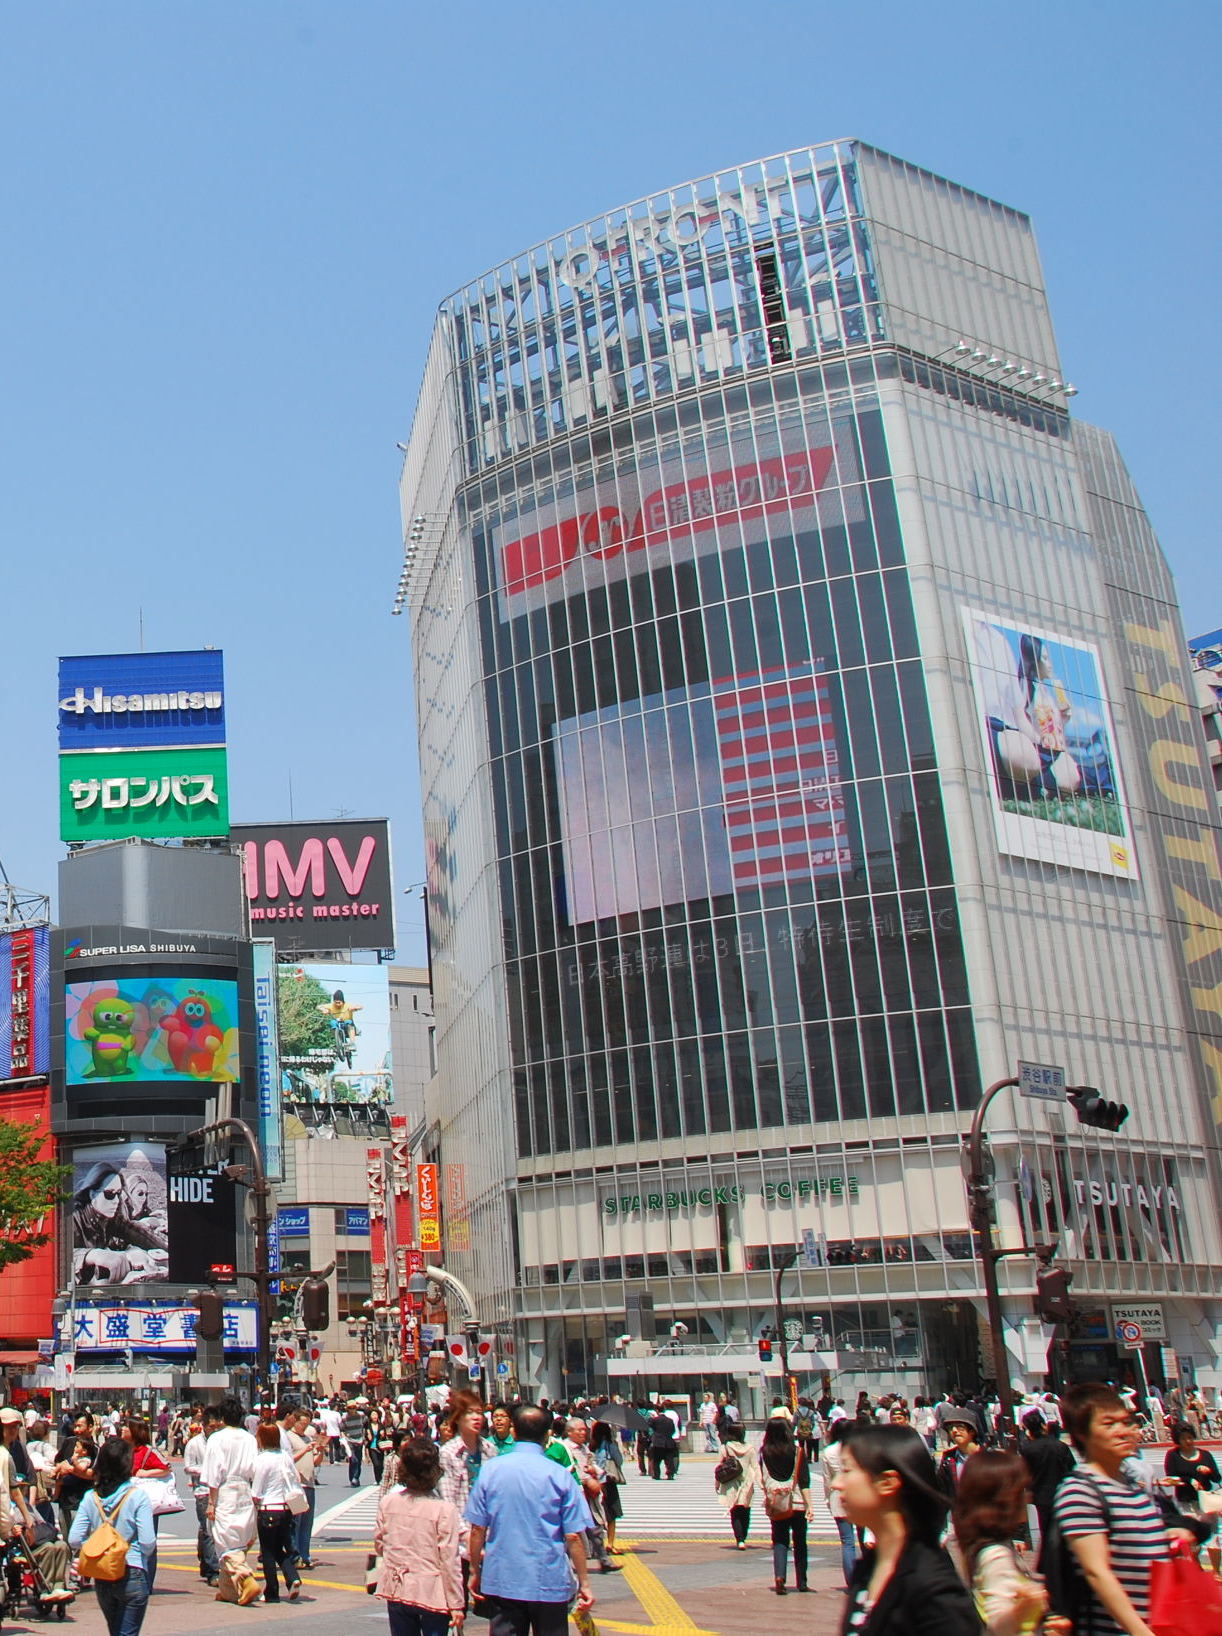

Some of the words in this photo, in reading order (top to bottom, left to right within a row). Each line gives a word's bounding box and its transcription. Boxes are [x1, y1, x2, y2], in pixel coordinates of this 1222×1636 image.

[59, 686, 222, 714] Hisamitsu
[69, 774, 219, 810] サロンパス
[251, 902, 304, 919] music
[312, 901, 380, 918] master
[79, 946, 117, 957] SUPER
[120, 944, 146, 953] LISA
[150, 943, 196, 953] SHIBUYA
[10, 934, 30, 1069] 三千里薬品
[256, 976, 273, 1047] Taisei
[258, 1054, 272, 1118] neon
[170, 1176, 214, 1203] HIDE
[604, 1183, 746, 1215] STARBUCKS
[760, 1175, 860, 1201] COFFEE
[1072, 1178, 1180, 1211] TSUTAYA
[74, 1313, 239, 1339] 大盛堂書店
[1115, 1309, 1162, 1318] TSUTAYA
